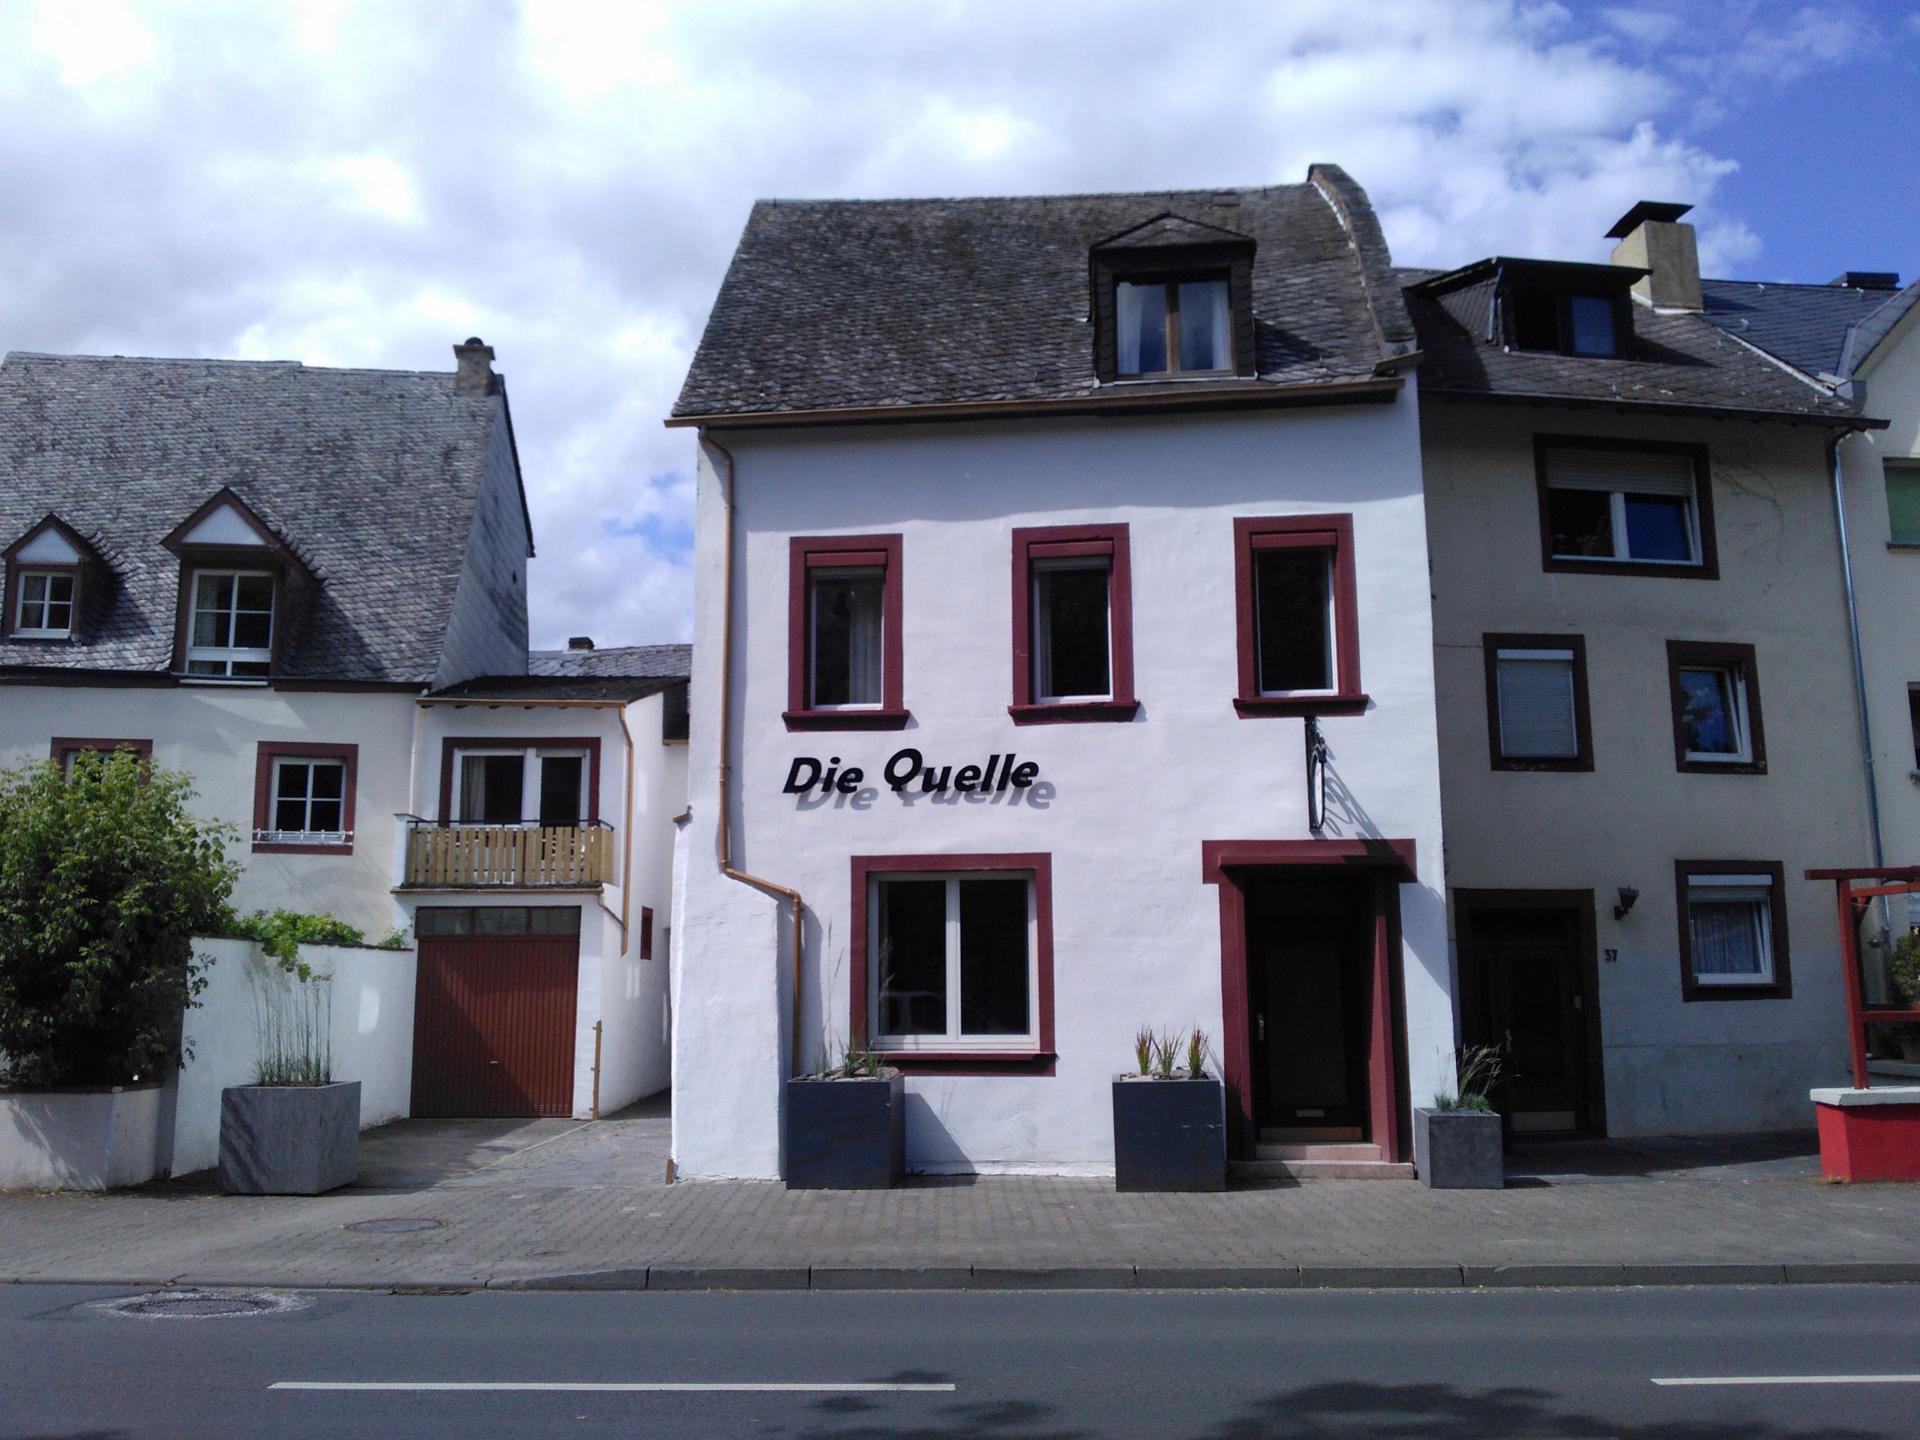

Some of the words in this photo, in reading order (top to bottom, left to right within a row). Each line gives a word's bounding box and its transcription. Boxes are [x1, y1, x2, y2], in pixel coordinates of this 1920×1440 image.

[782, 756, 864, 794] Die
[884, 748, 1039, 793] Quelle
[1604, 948, 1618, 962] 37
